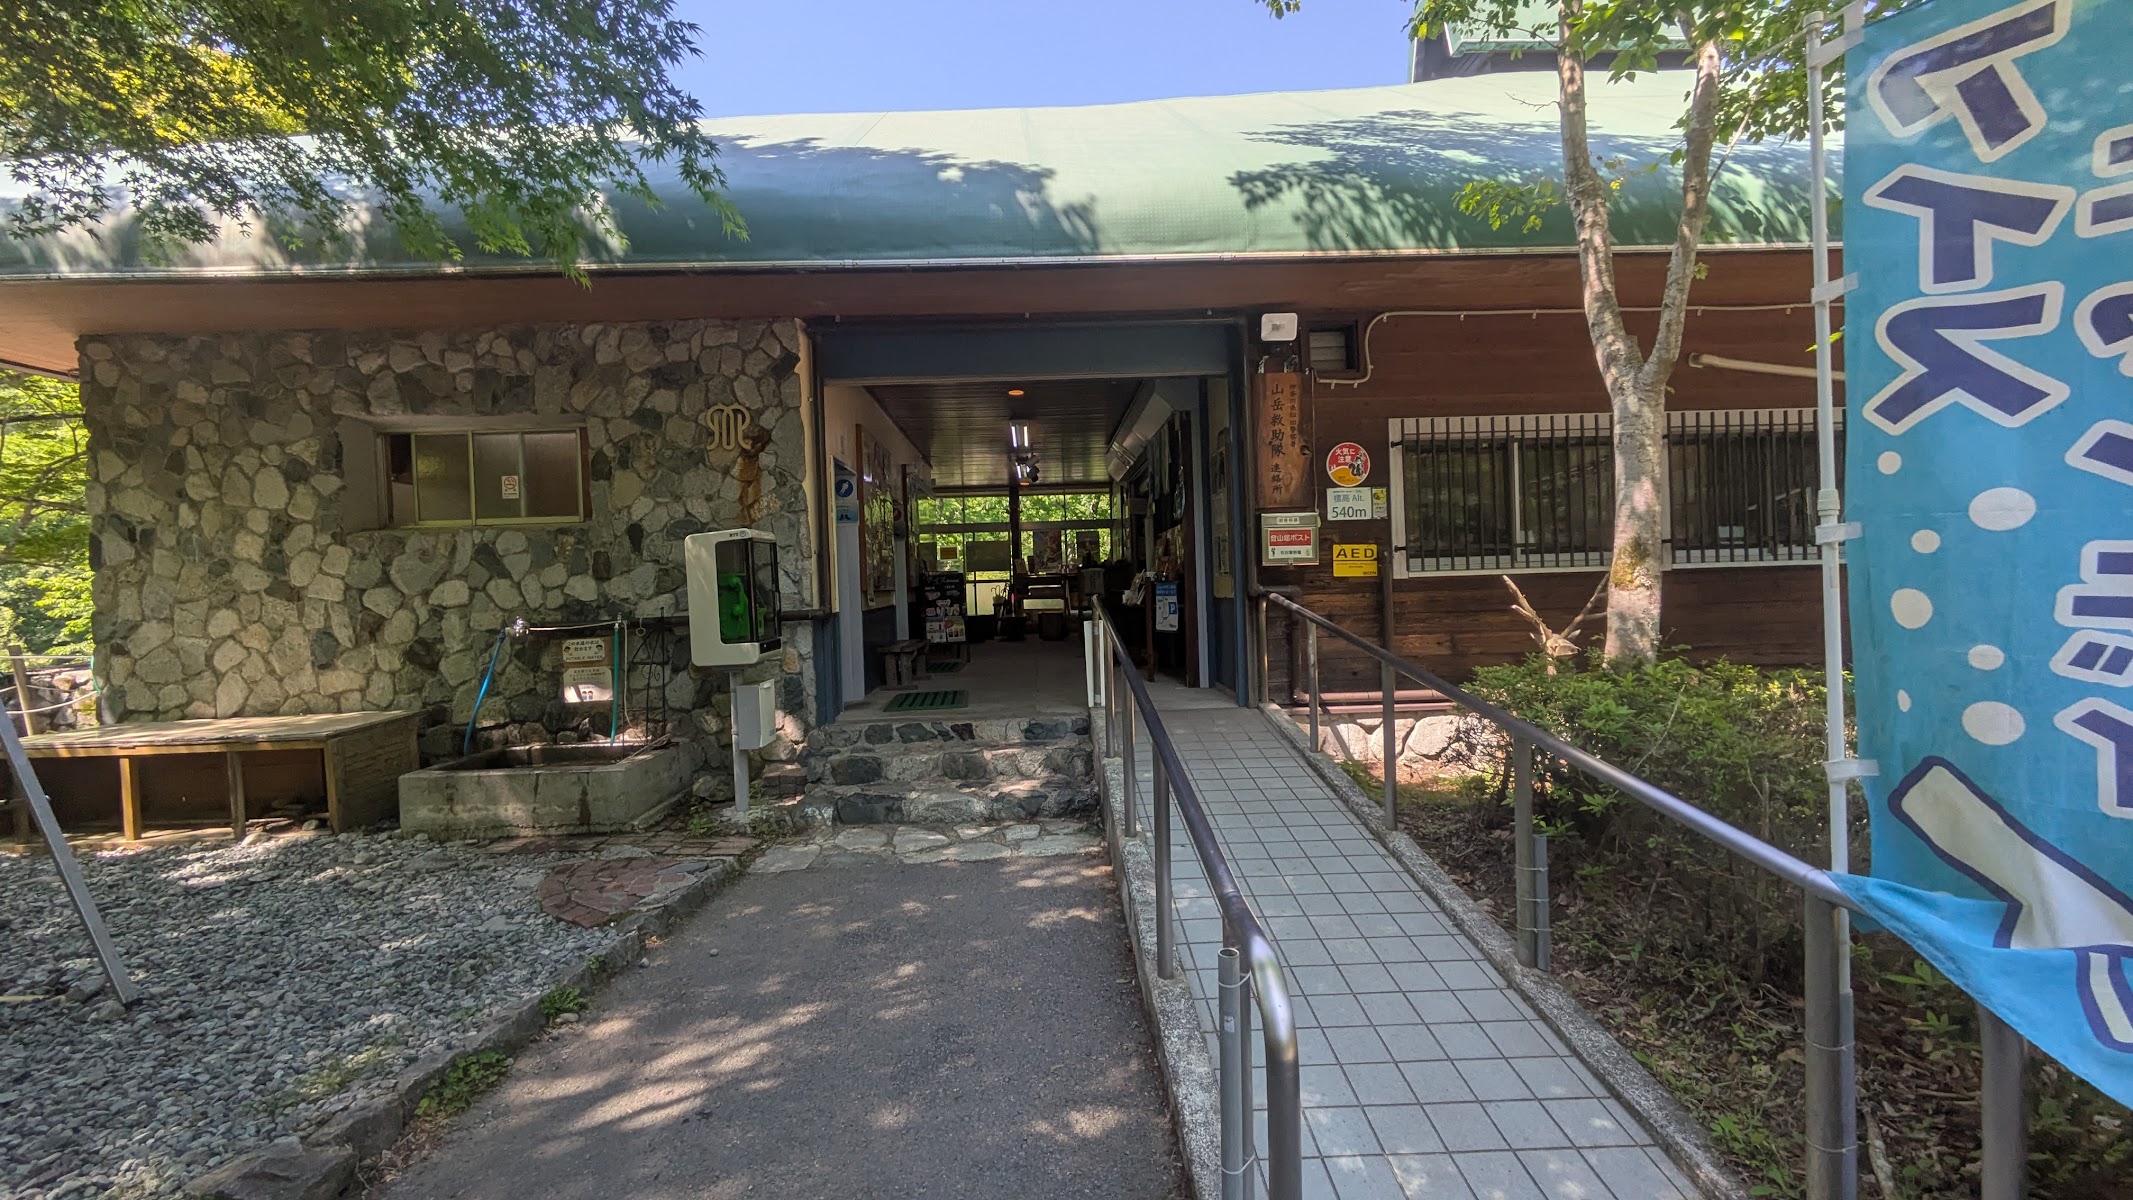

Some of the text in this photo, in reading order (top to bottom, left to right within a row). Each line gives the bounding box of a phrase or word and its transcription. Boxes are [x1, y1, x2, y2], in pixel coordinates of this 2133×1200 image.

[1333, 495, 1350, 503] 標高
[1331, 506, 1367, 518] 540m
[1270, 534, 1310, 542] 登山届ポスト
[1335, 548, 1374, 558] AED
[1169, 603, 1176, 613] P
